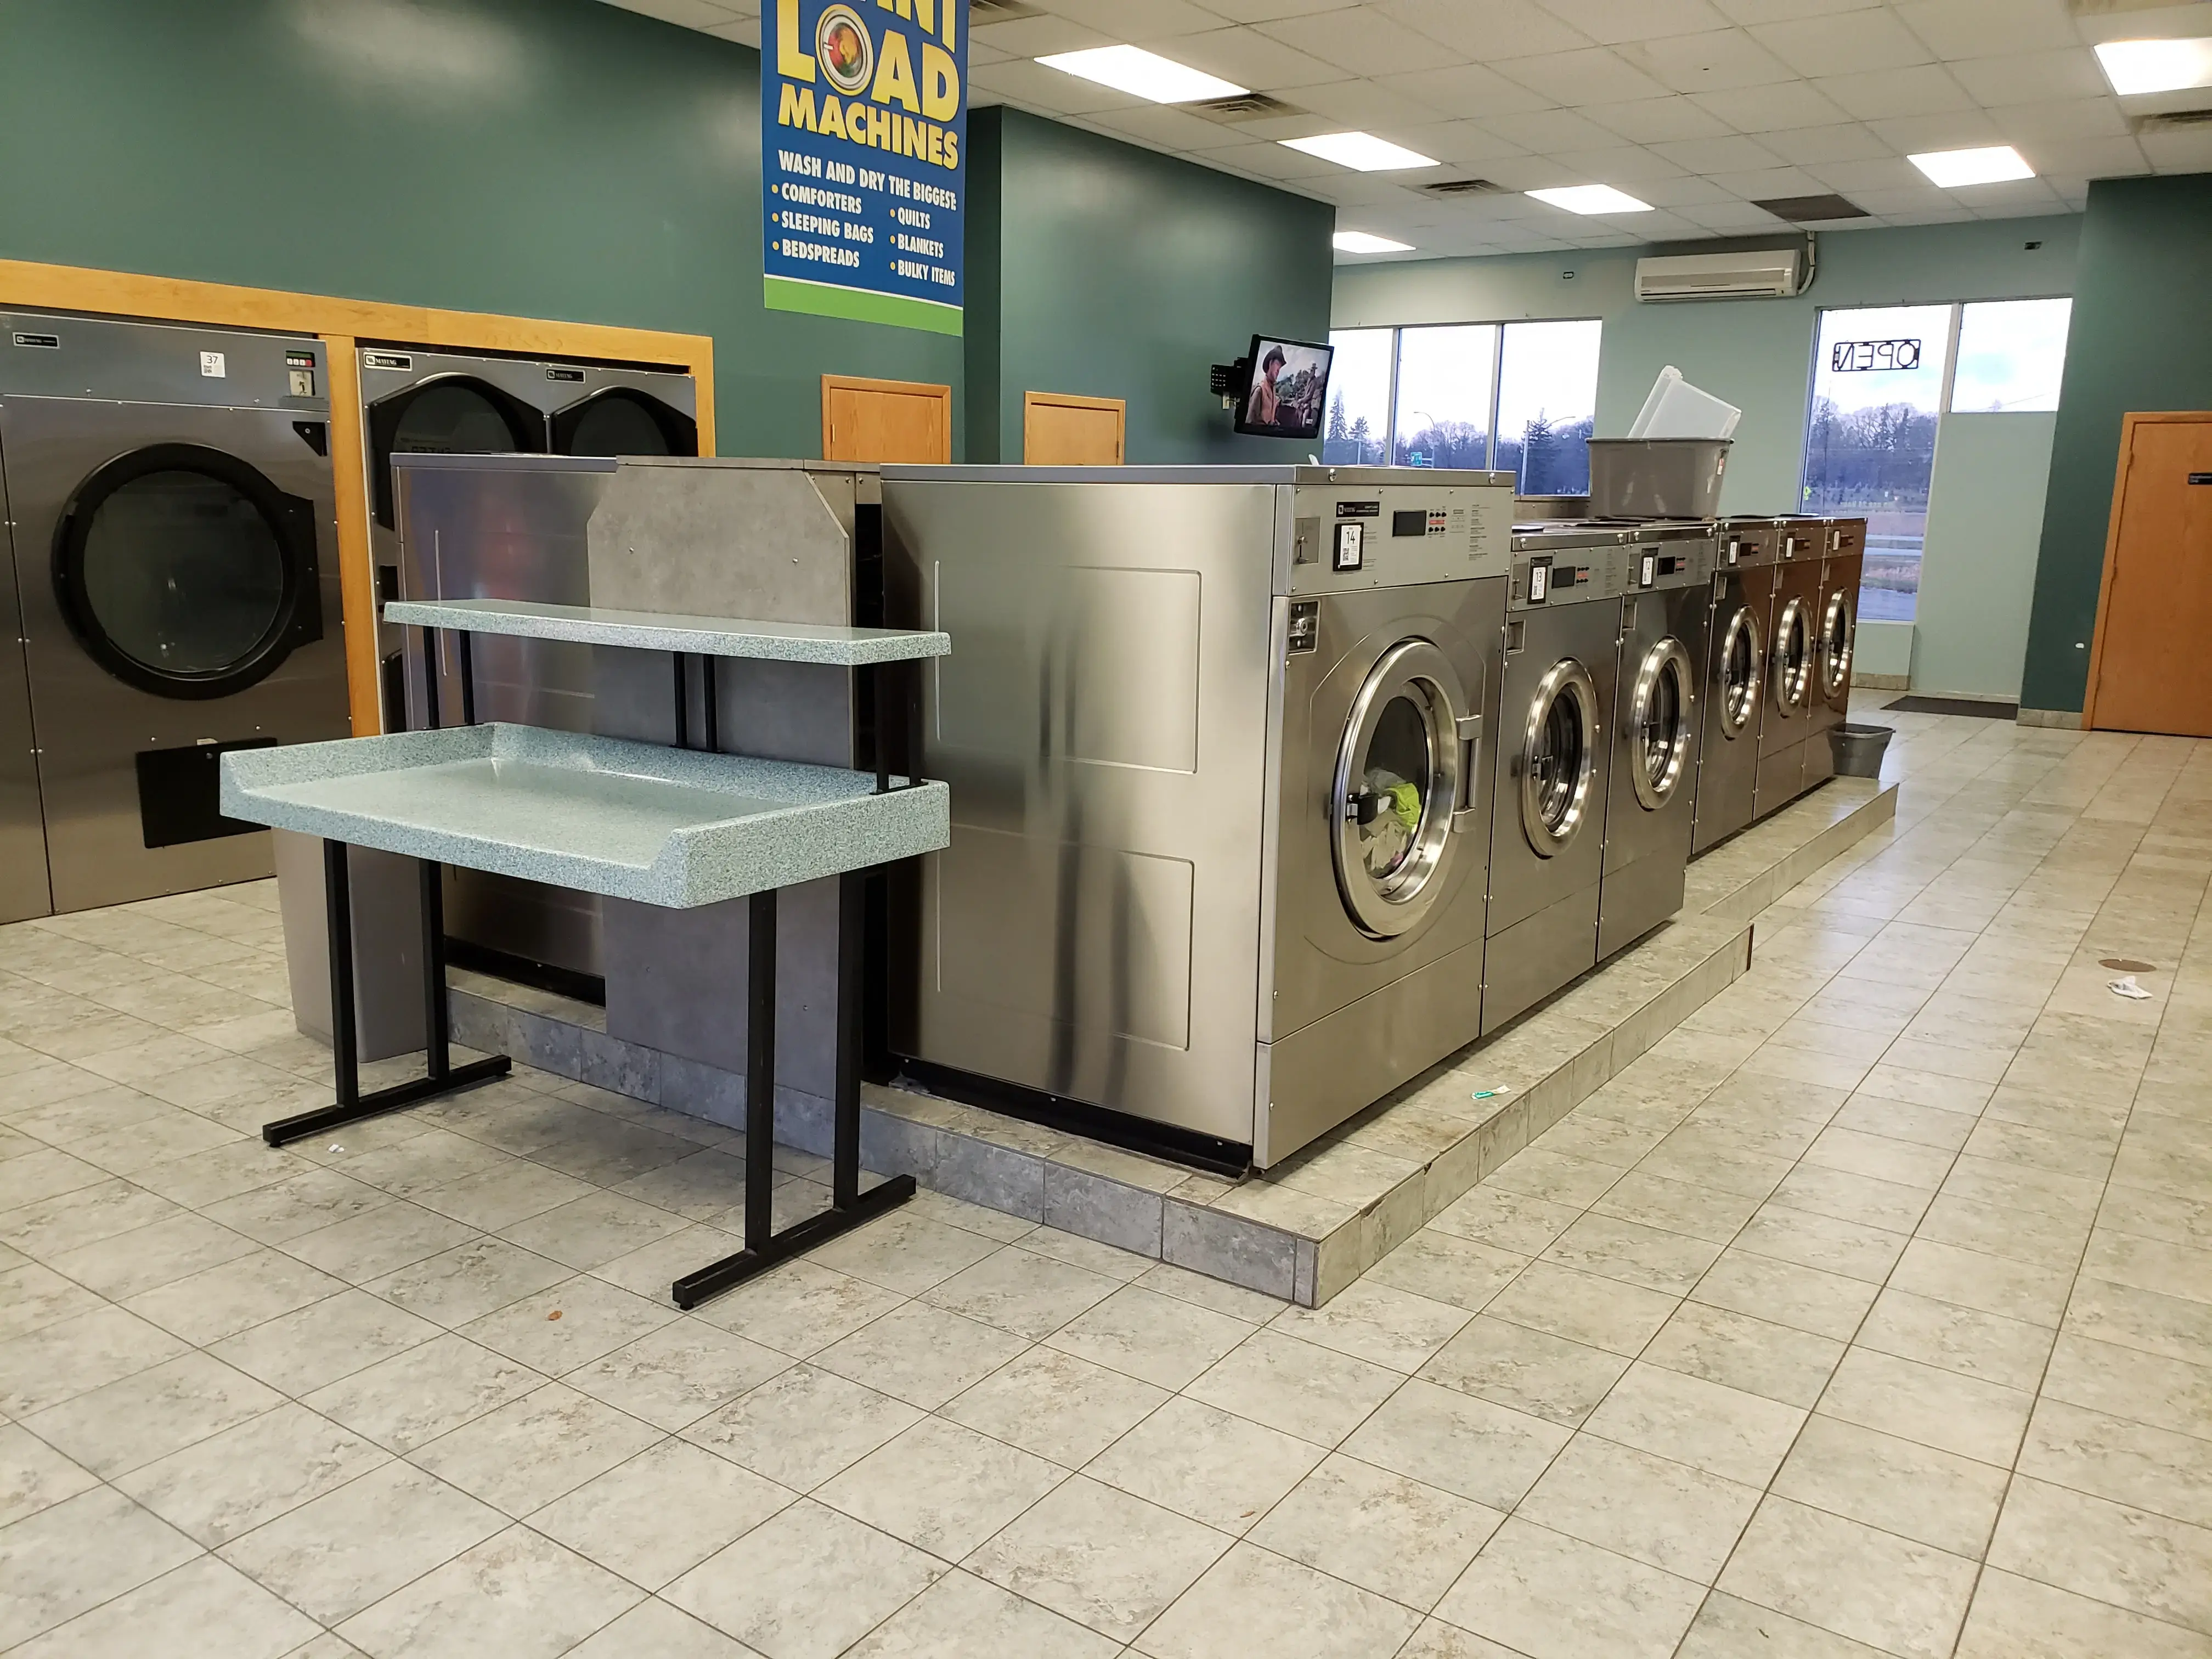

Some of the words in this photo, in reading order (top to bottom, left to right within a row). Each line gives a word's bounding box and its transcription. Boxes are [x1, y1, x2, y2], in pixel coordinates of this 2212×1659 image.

[777, 0, 960, 122] LOAD
[778, 82, 958, 170] MACHINES
[778, 150, 821, 178] WASH
[826, 161, 855, 184] AND
[860, 168, 885, 191] DRY
[889, 175, 910, 198] THE
[782, 182, 861, 214] COMFORTERS
[782, 211, 840, 238] SLEEPING
[844, 222, 873, 244] BAGS
[898, 207, 930, 229] QUILTS
[782, 239, 860, 268] BEDSPREADS
[898, 234, 944, 258] BLANKETS
[898, 259, 929, 281] BULKY
[932, 266, 955, 287] ITEMS
[206, 355, 218, 364] 37
[1346, 531, 1356, 545] 14
[1536, 571, 1542, 582] 13
